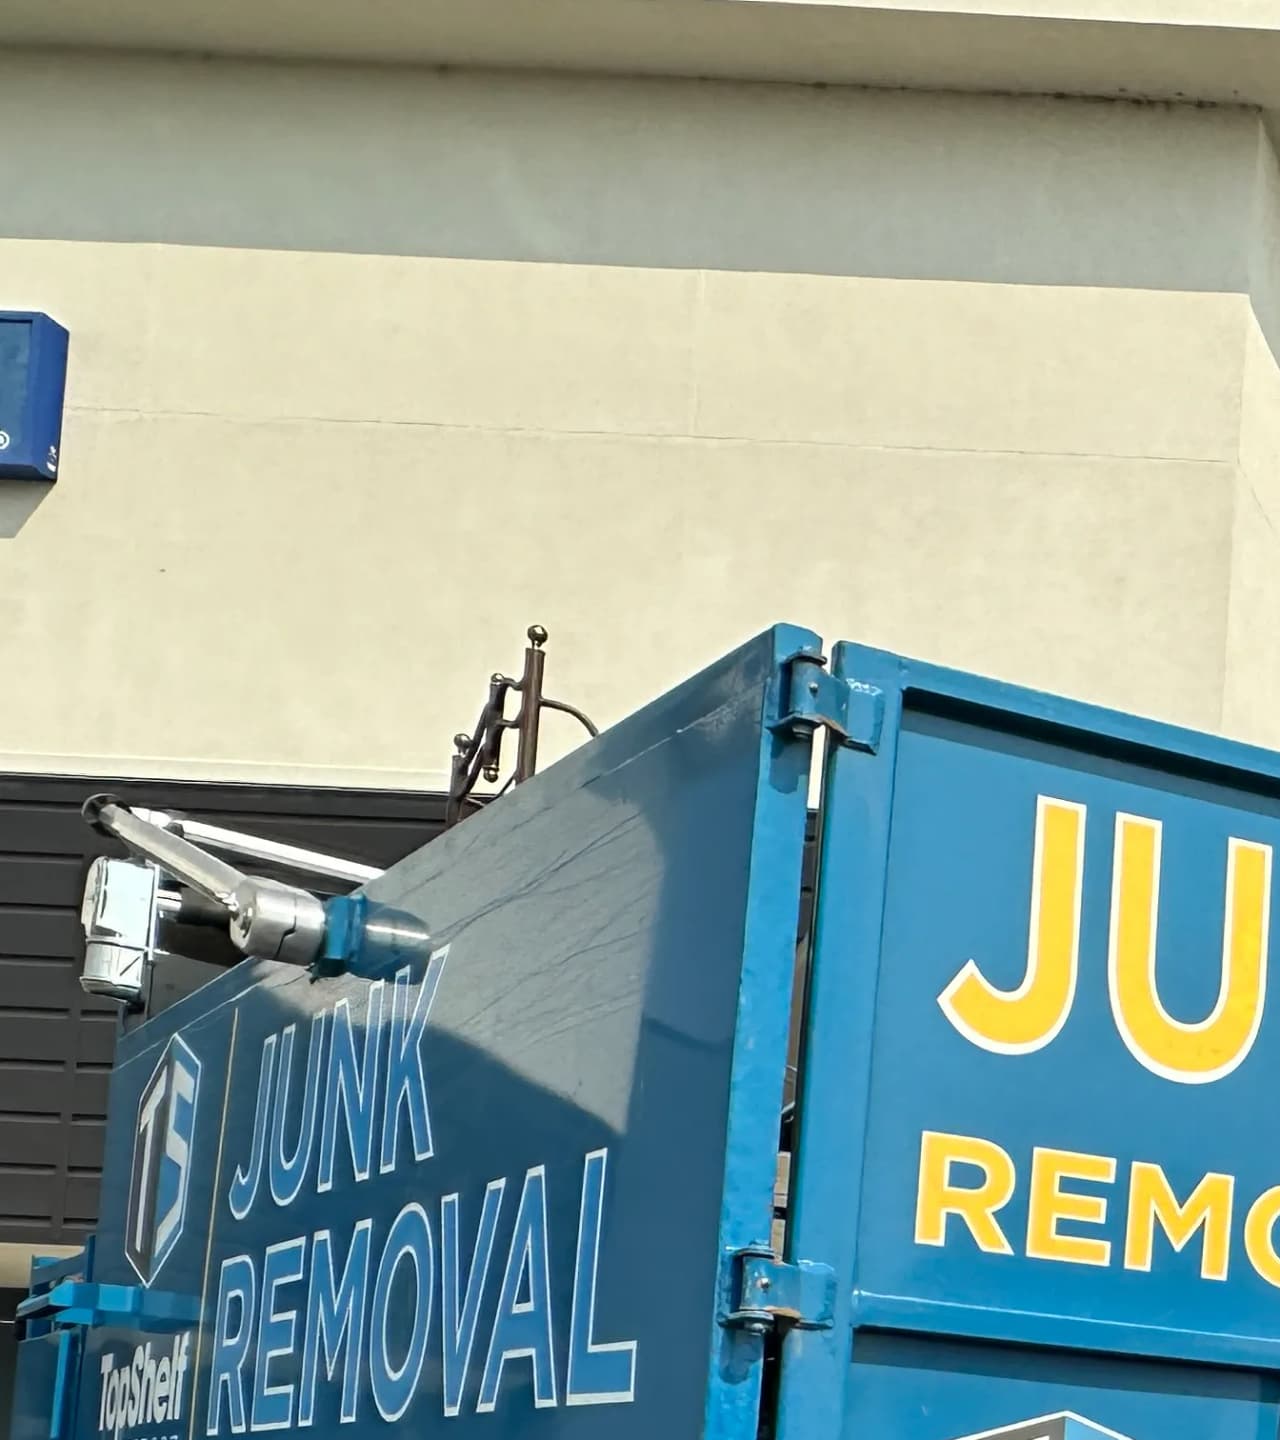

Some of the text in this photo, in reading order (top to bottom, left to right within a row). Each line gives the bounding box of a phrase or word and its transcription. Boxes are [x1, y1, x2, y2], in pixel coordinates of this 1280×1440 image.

[133, 1056, 196, 1263] TS
[228, 943, 450, 1221] JUNK
[206, 1147, 639, 1437] REMOVAL
